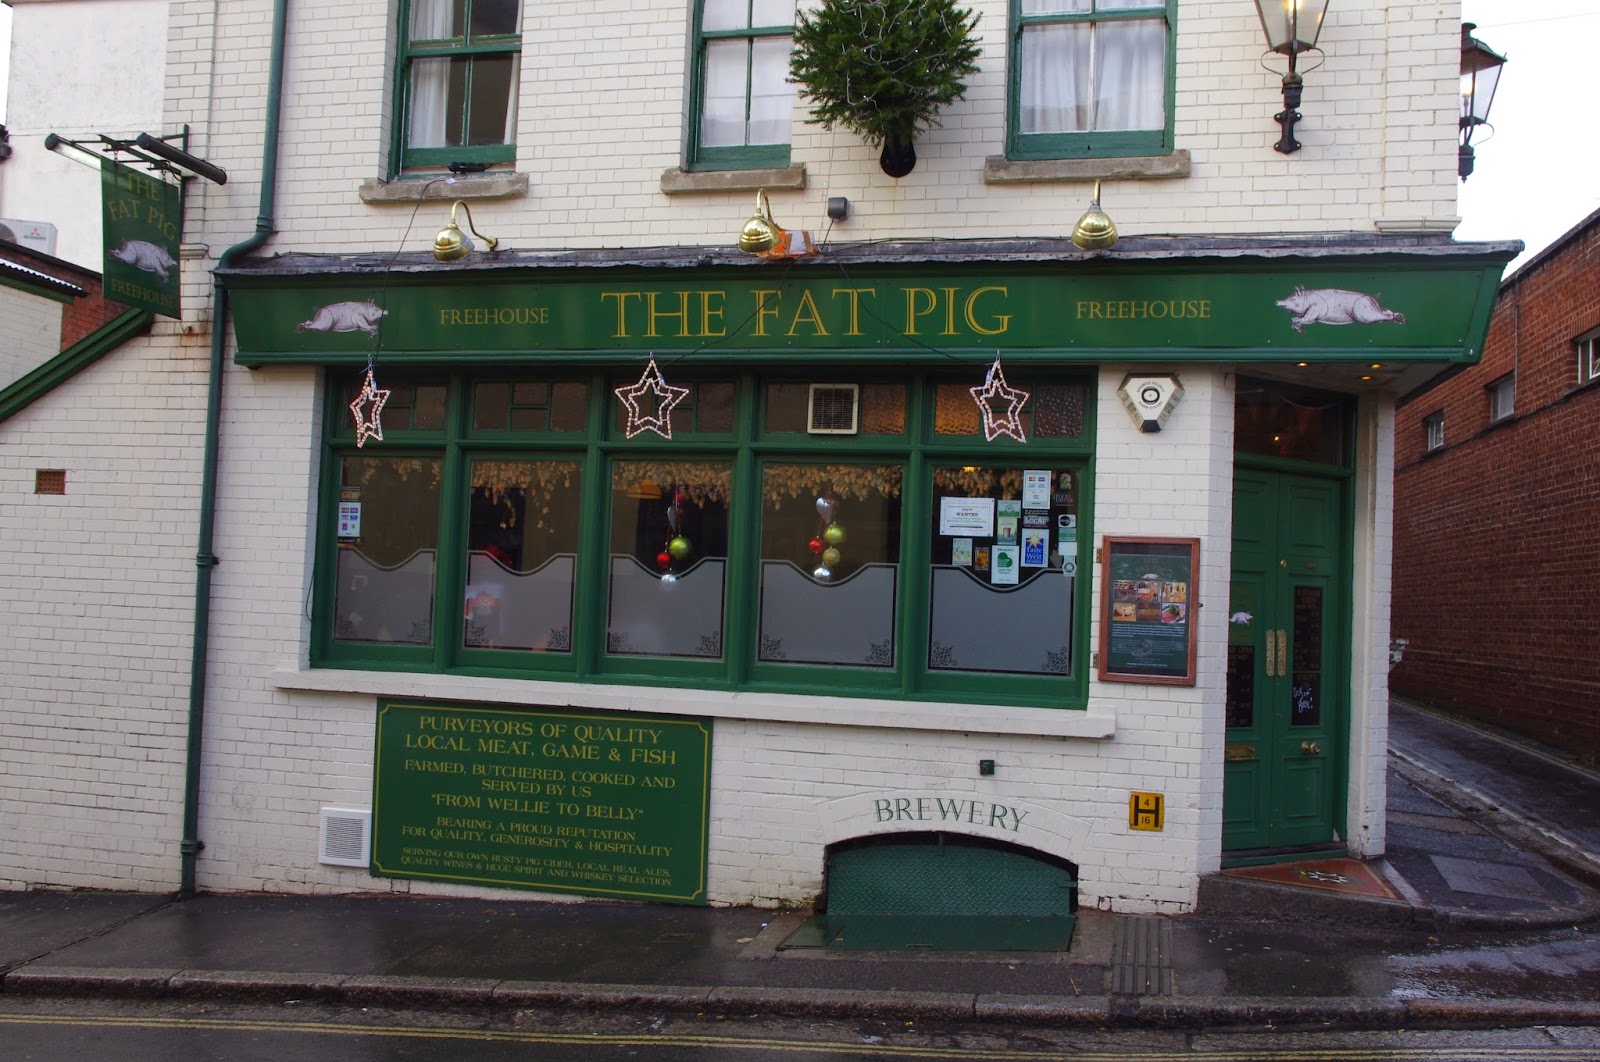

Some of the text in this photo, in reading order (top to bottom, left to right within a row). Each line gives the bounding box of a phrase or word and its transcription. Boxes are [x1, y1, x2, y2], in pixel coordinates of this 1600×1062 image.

[124, 170, 160, 201] THE
[106, 198, 177, 241] FAT PIG
[111, 278, 175, 308] FREEHOUSE
[440, 307, 549, 325] FREEHOUSE
[600, 286, 1014, 337] THE FAT PIG
[1075, 300, 1211, 320] FREEHOUSE
[1026, 552, 1042, 560] West
[420, 716, 663, 744] PURVEYORS OF QUALITY
[406, 734, 675, 765] LOCAL MEAT, GAME & FISH
[473, 764, 565, 782] BUTCHERED,
[572, 771, 634, 786] COOKED
[642, 776, 675, 789] AND
[482, 779, 591, 798] SERVED BY US
[488, 798, 549, 814] WELLIE
[557, 803, 579, 816] TO
[873, 797, 1031, 833] BREWERY
[1142, 816, 1150, 824] 16
[402, 825, 426, 836] FOR
[491, 833, 569, 848] GENEROSITY
[575, 840, 583, 849] &
[590, 841, 672, 857] HOSPITALITY
[437, 816, 635, 841] BEARING A PROUD REPUTATION
[401, 856, 671, 886] QUALITY WINES & HUGE SPIRIT AND WHISKEY SELECTION
[403, 847, 441, 857] SERVING
[445, 851, 463, 859] OUR
[467, 853, 488, 861] OWN
[492, 855, 521, 864] RUSTY
[525, 857, 540, 866] PIG
[577, 861, 609, 871] LOCAL
[613, 864, 640, 874] REAL
